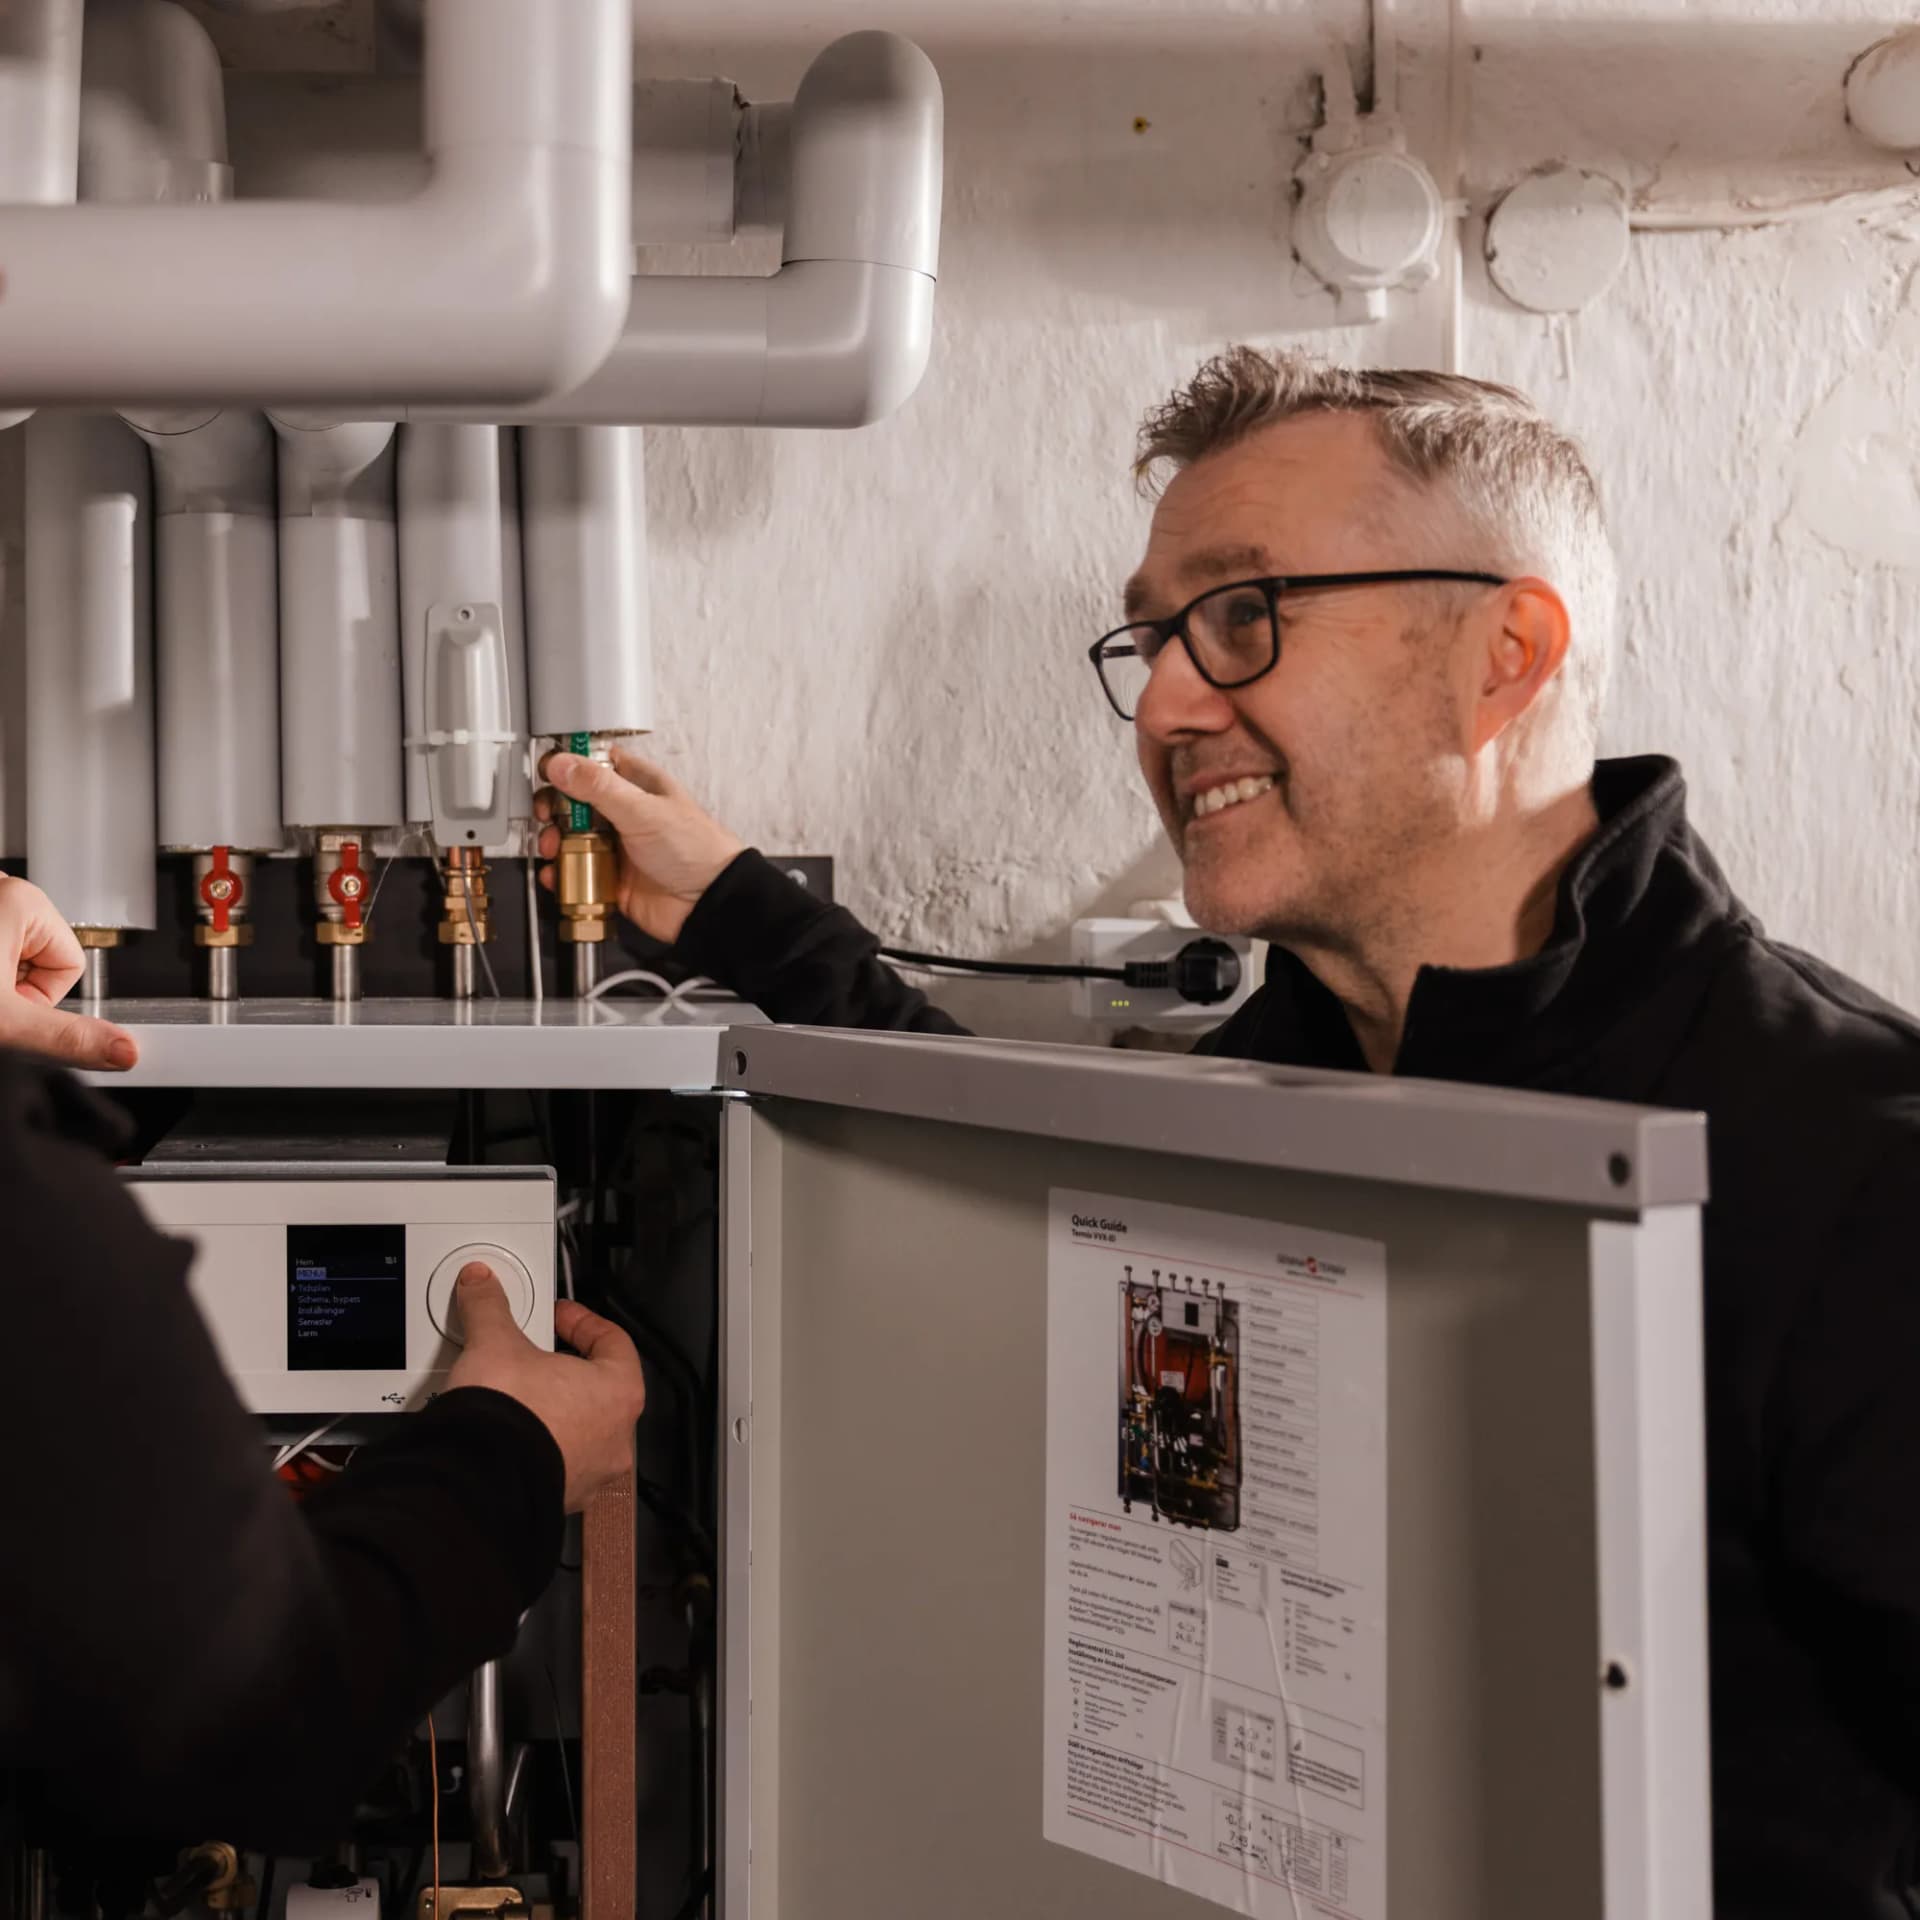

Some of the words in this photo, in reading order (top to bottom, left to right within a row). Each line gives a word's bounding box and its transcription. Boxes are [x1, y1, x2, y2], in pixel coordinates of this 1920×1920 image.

[1071, 1214, 1098, 1228] Quick
[1100, 1218, 1128, 1233] Guide
[295, 1258, 314, 1266] Hem
[297, 1329, 318, 1337] Larm
